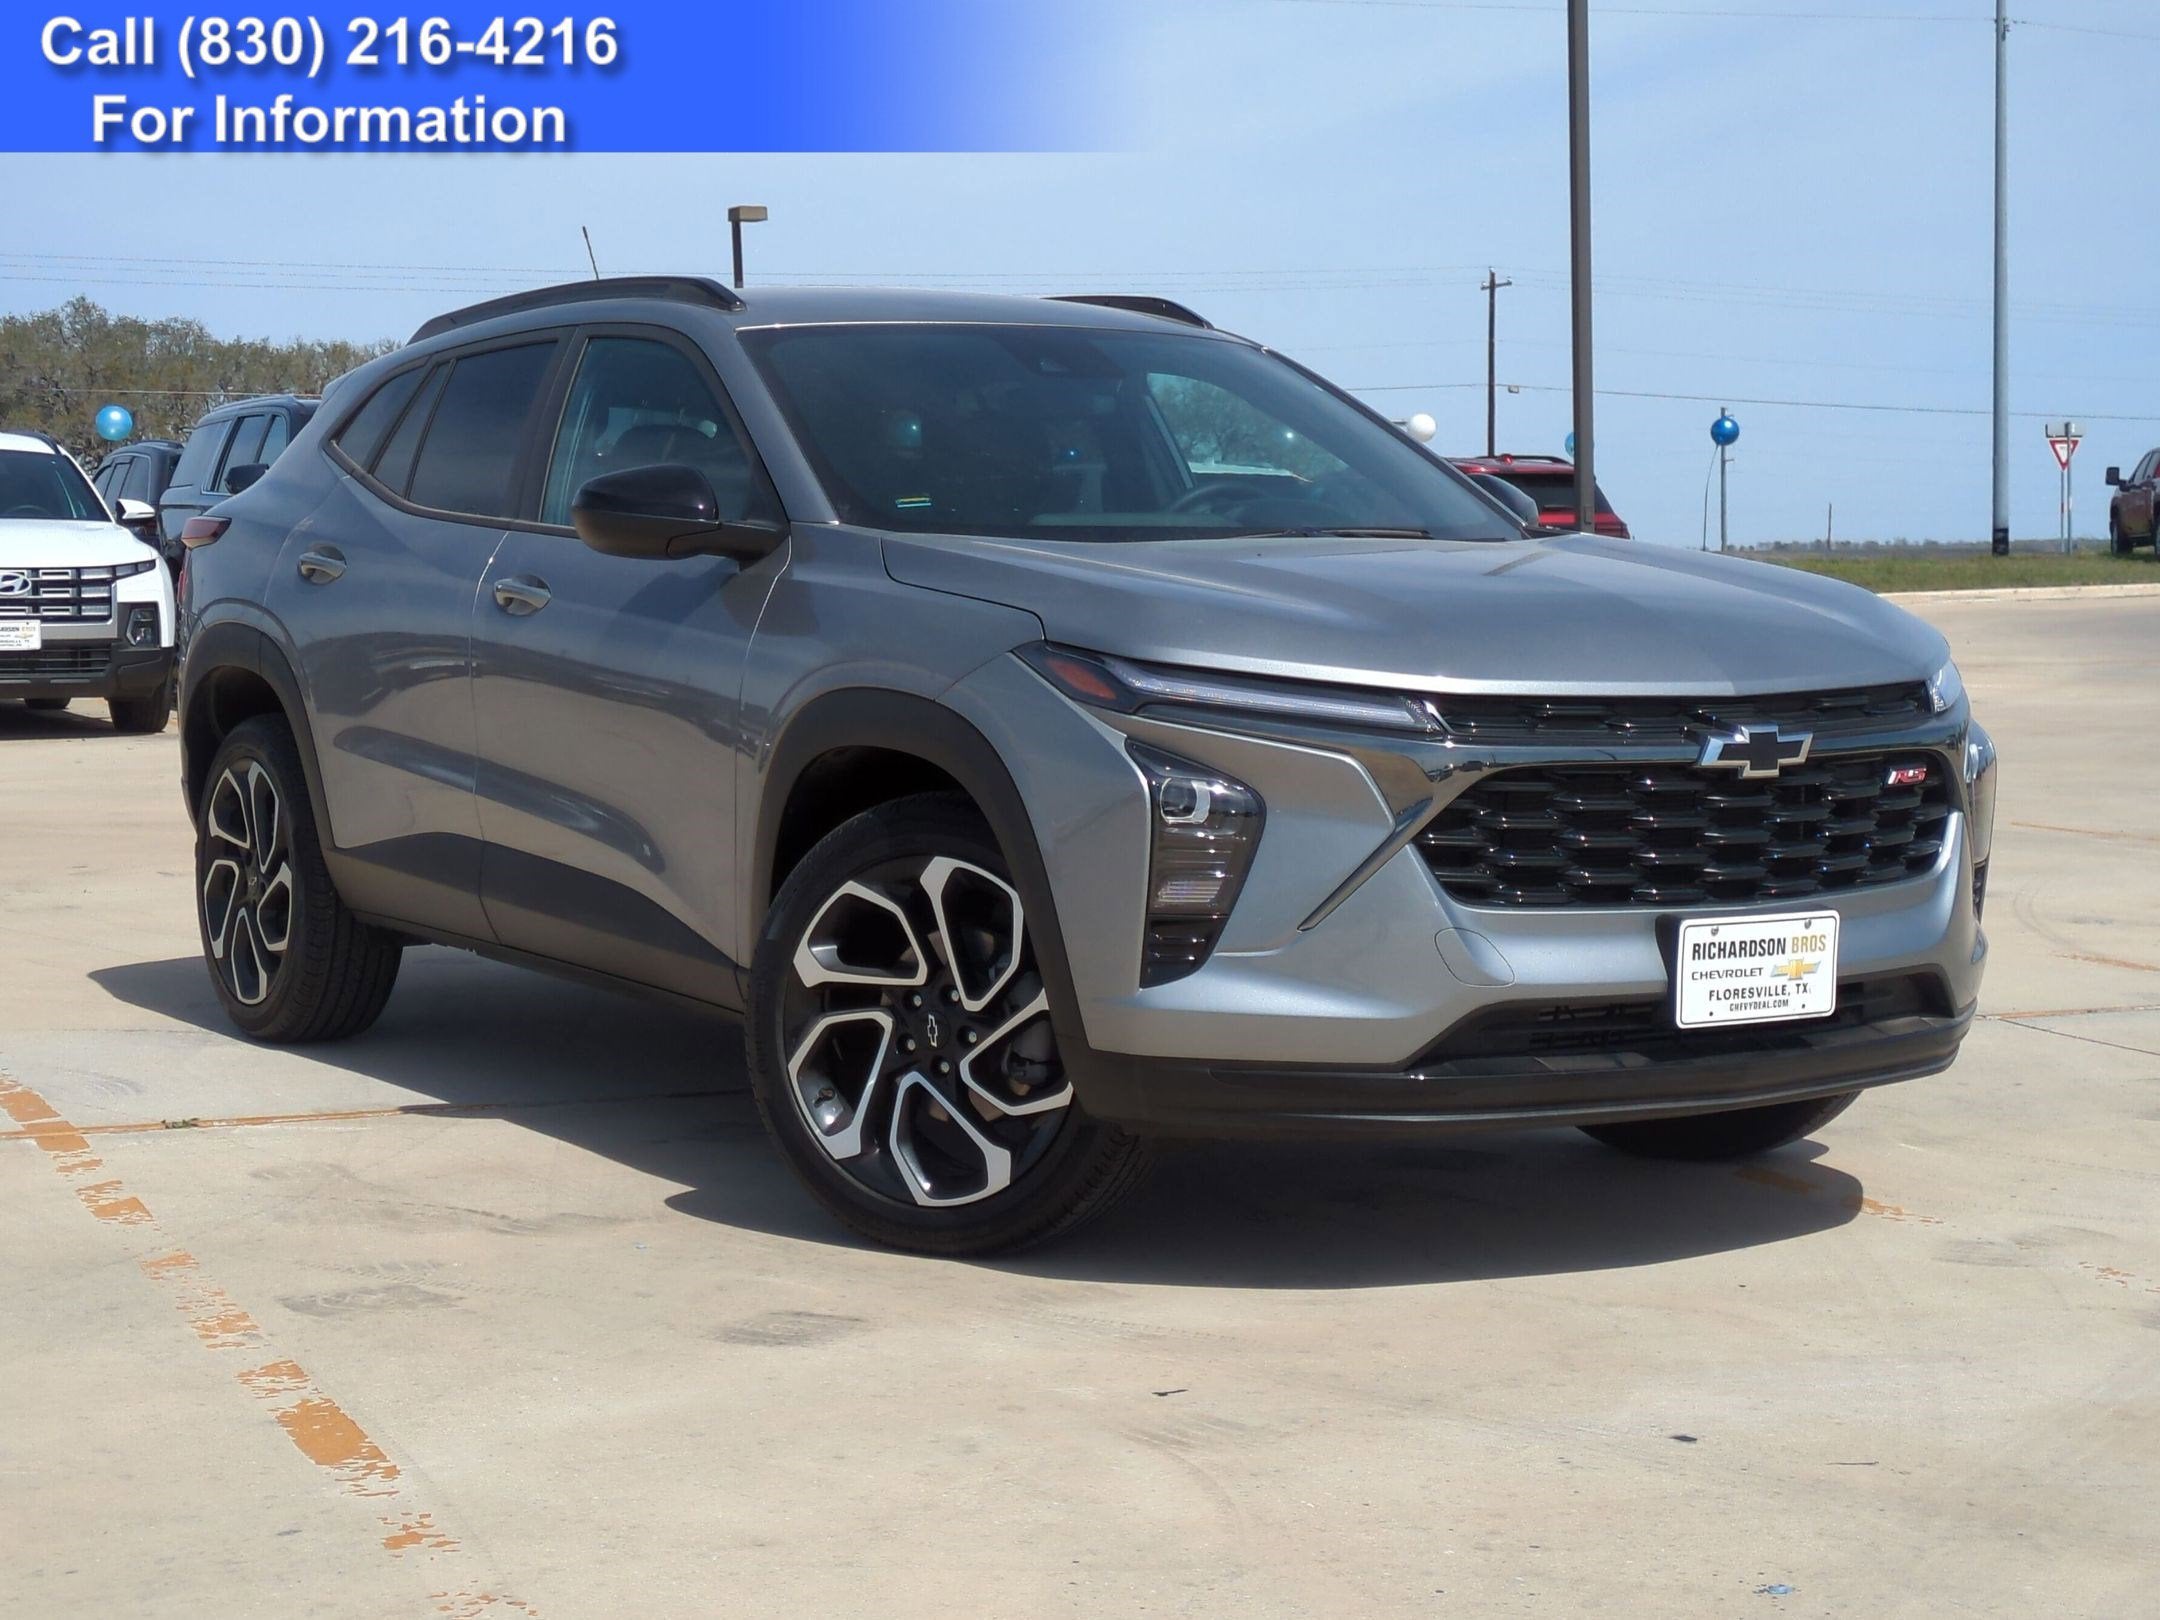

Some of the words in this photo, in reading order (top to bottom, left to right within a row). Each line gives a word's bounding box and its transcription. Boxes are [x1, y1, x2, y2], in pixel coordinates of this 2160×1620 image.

[1692, 937, 1786, 961] RICHARDSON
[1791, 934, 1826, 954] BROS
[1691, 967, 1764, 981] CHEVROLET
[1708, 984, 1791, 1001] FLORESVILLE,
[1729, 999, 1789, 1012] CHEVYDEAL.COM
